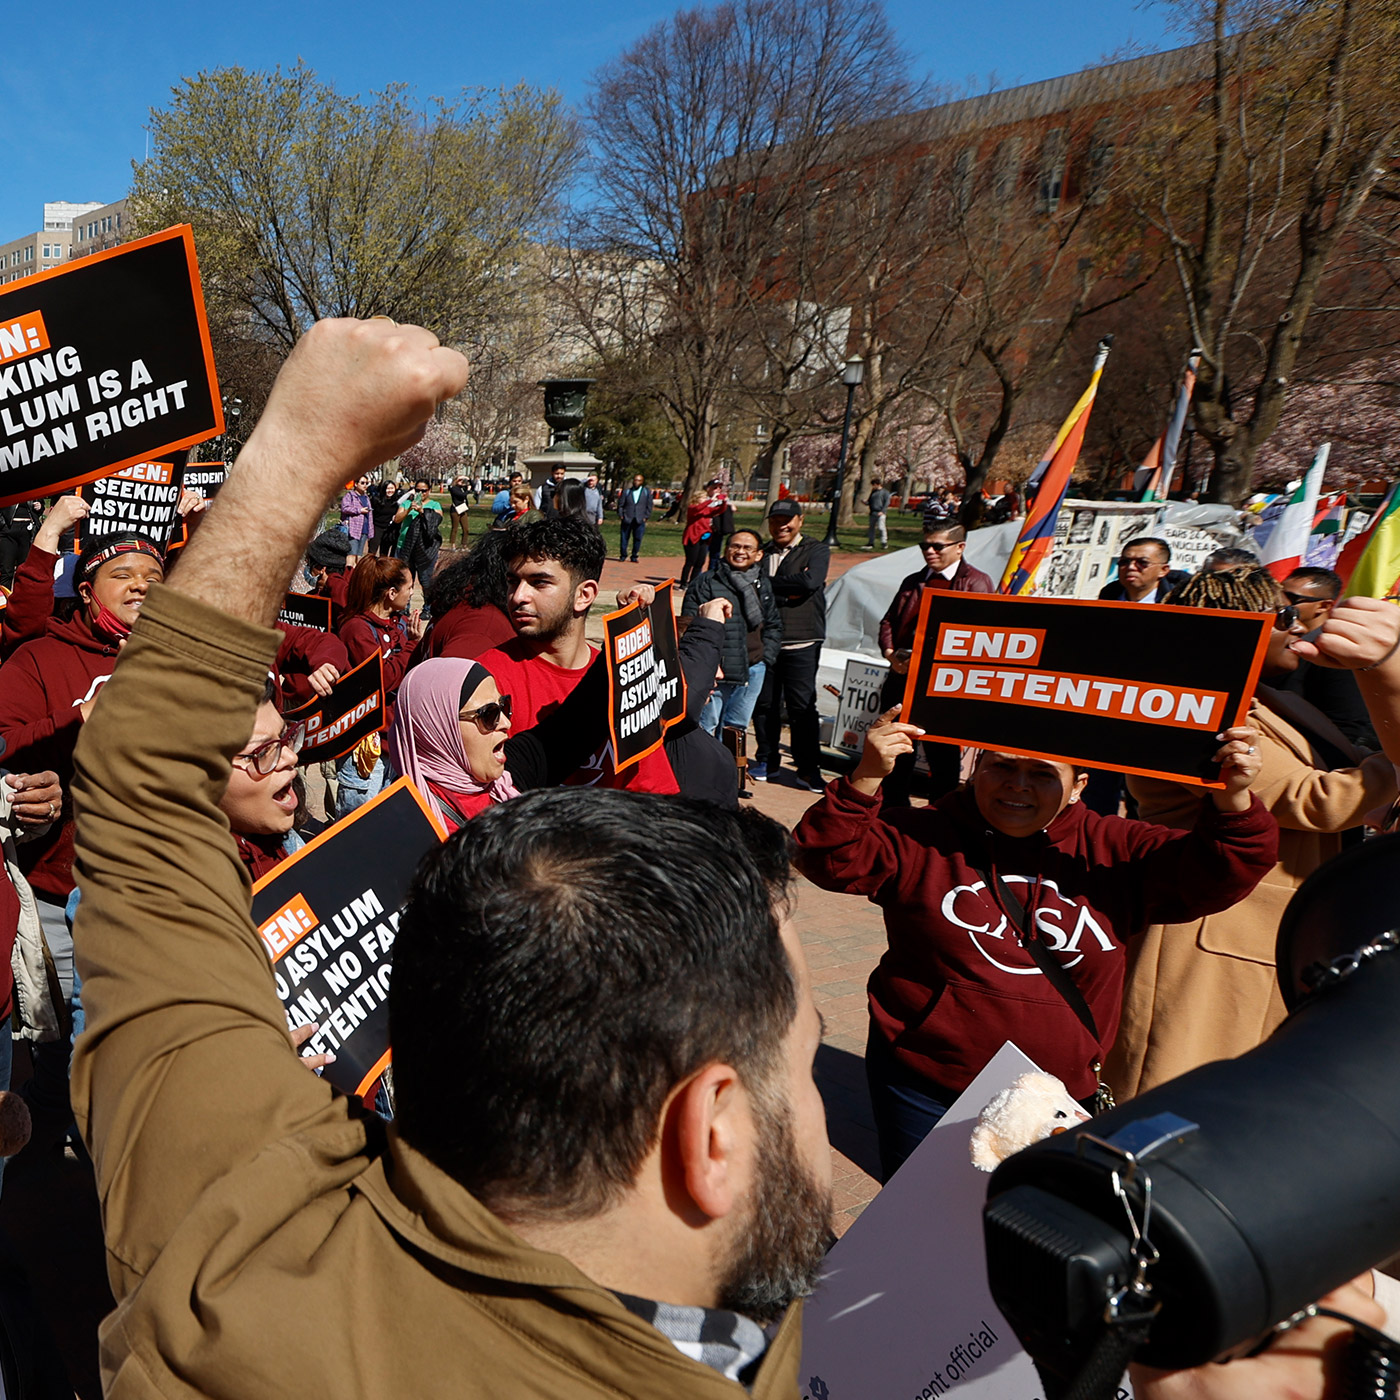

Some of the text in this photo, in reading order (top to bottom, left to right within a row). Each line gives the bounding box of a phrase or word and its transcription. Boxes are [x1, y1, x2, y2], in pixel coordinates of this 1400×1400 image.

[87, 368, 123, 406] IS
[130, 358, 154, 391] A
[85, 379, 189, 443] RIGHT
[89, 498, 172, 523] ASYLUM
[93, 477, 178, 503] SEEKING
[940, 629, 1038, 661] END
[848, 686, 883, 715] THO
[933, 667, 1216, 726] DETENTION
[284, 888, 385, 988] ASYLUM
[321, 950, 363, 997] NO
[358, 911, 401, 964] FA
[945, 1320, 999, 1381] official
